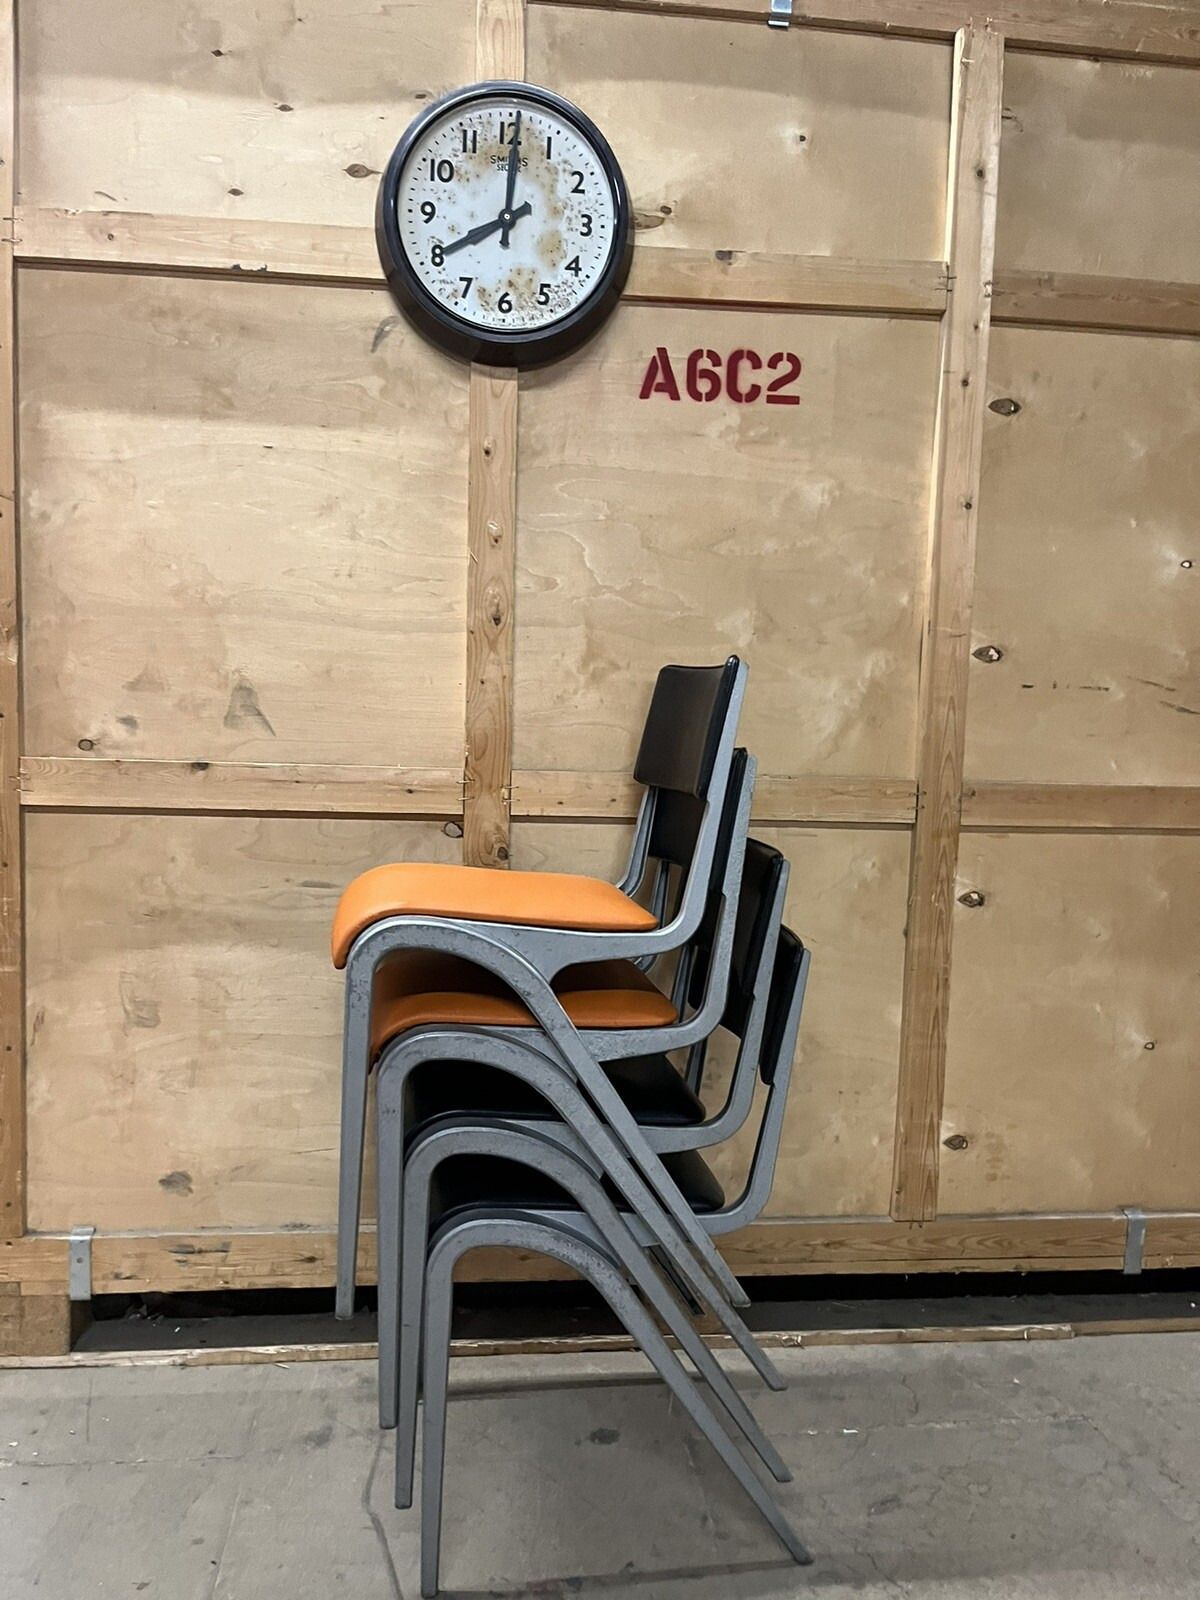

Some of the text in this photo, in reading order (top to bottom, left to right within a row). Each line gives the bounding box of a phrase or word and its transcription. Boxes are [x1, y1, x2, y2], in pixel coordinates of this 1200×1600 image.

[462, 129, 477, 154] 11
[499, 122, 522, 146] 12
[546, 136, 552, 160] 1
[430, 159, 454, 183] 10
[490, 155, 529, 167] SMIS
[571, 171, 585, 194] 2
[421, 201, 436, 224] 9
[580, 214, 593, 237] 3
[431, 244, 444, 267] 8
[565, 255, 582, 277] 4
[459, 277, 473, 299] 7
[538, 283, 552, 305] 5
[498, 292, 513, 314] 6
[639, 347, 802, 405] A6C2
